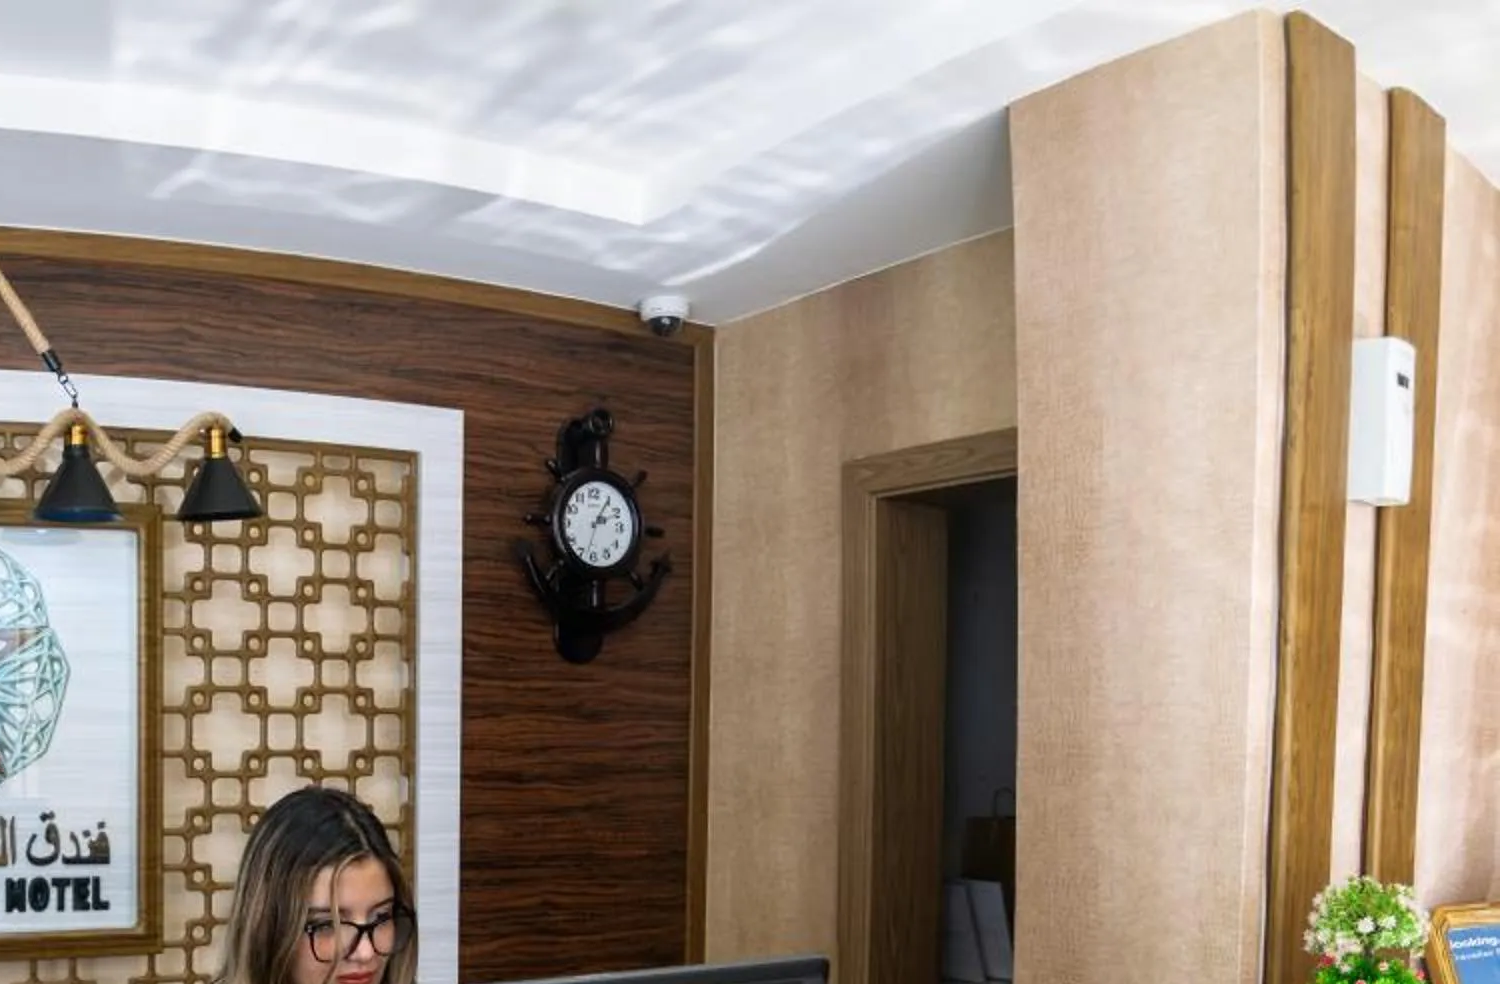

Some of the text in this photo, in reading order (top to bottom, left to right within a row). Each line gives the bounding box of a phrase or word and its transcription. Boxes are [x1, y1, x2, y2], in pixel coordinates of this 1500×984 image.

[575, 492, 585, 504] 11
[587, 487, 600, 500] 12
[612, 507, 621, 519] 2
[26, 810, 111, 866] فندق
[5, 875, 111, 913] HOTEL
